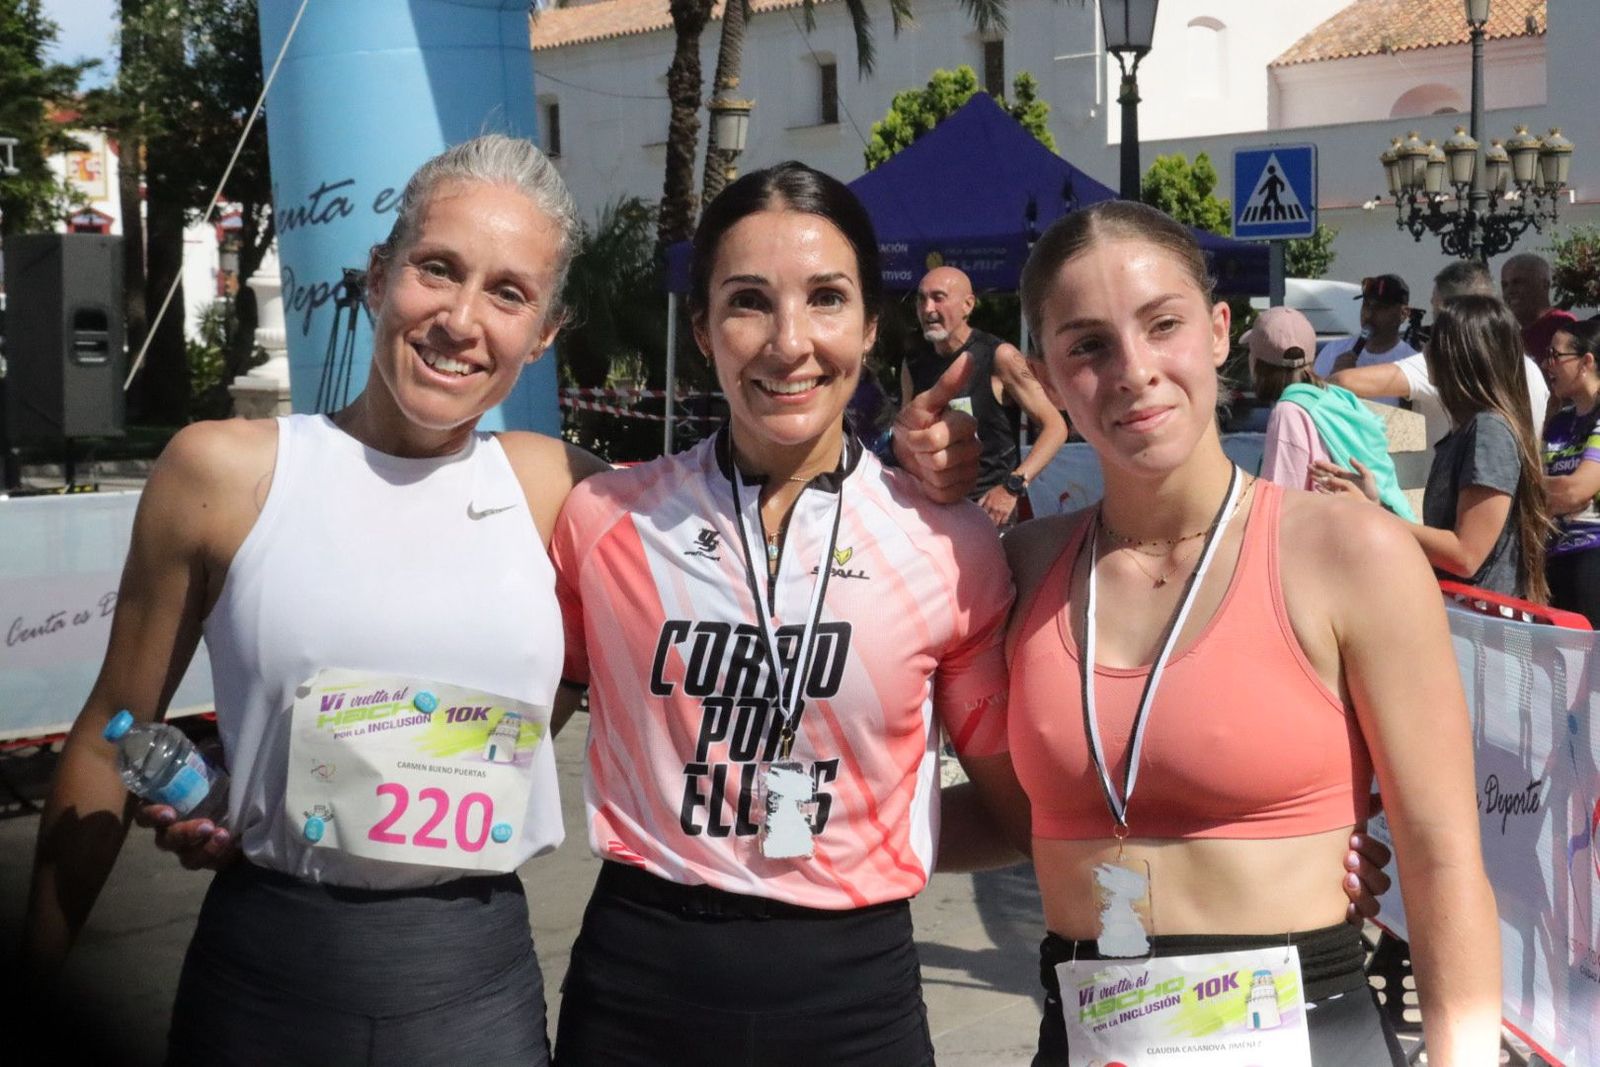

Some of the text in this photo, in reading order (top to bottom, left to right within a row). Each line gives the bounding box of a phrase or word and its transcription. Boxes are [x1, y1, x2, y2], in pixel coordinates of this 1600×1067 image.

[444, 706, 493, 724] 10K
[334, 729, 353, 740] POR
[354, 727, 366, 737] LA
[397, 760, 487, 778] CARMEN BUENO PUERTAS
[680, 758, 840, 838] ELLS
[1484, 774, 1542, 836] Deporte
[368, 782, 494, 852] 220
[1192, 971, 1239, 1000] 10K
[1092, 1022, 1108, 1032] POR
[1109, 1019, 1119, 1028] LA
[1146, 1045, 1181, 1055] CLAUDIA
[1182, 1043, 1226, 1053] CASANOVA
